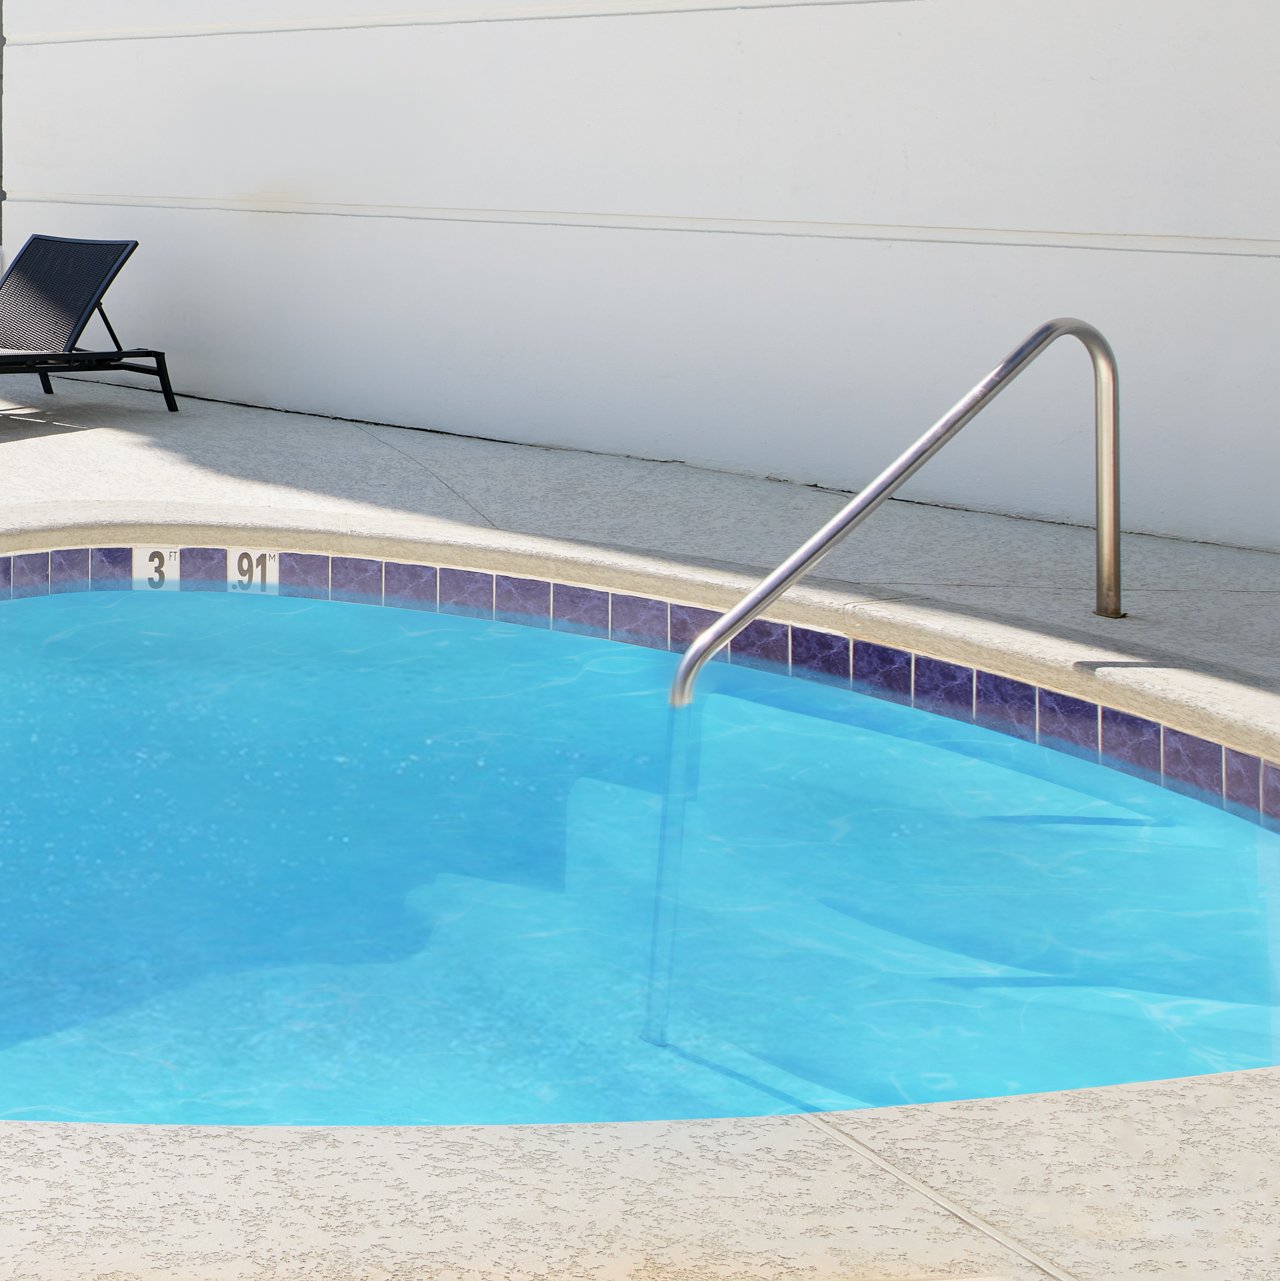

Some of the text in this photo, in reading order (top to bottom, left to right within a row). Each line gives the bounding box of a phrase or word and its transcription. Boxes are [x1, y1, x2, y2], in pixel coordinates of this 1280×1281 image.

[147, 550, 178, 589] 3 FT
[231, 551, 276, 592] .91 M
